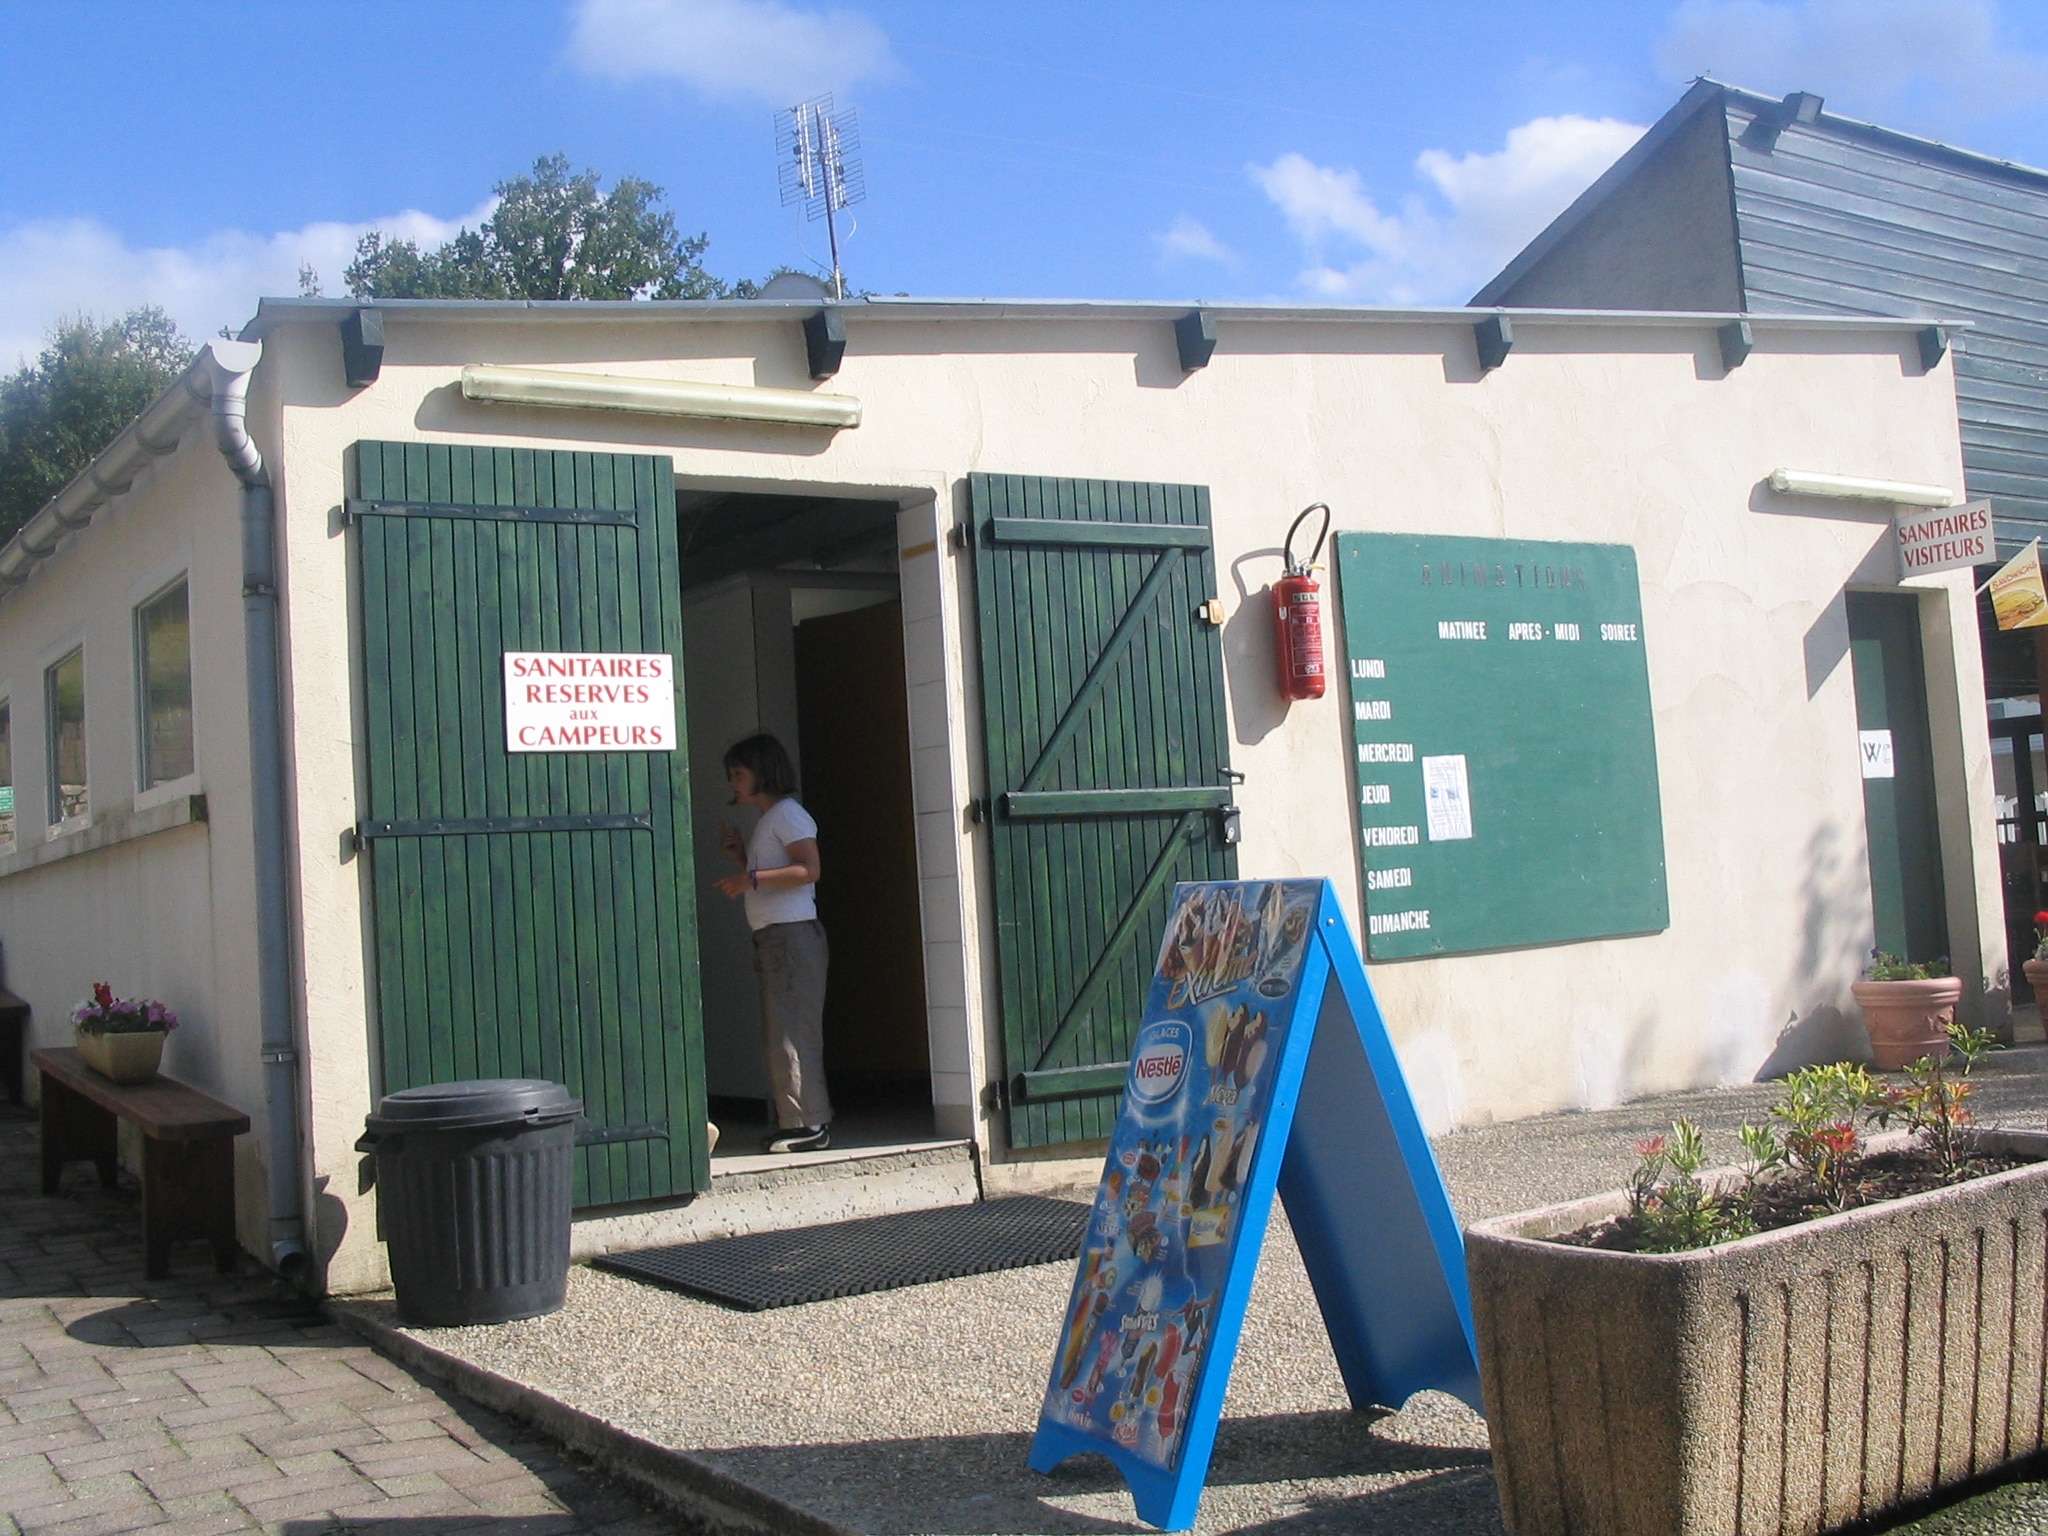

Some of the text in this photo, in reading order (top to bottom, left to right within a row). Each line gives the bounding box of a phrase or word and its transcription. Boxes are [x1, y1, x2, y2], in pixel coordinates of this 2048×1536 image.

[1899, 509, 1987, 545] SANITAIRES
[1904, 535, 1985, 567] VISITEURS
[1438, 621, 1487, 640] MATINEE
[1508, 622, 1542, 640] APRES
[1554, 623, 1580, 641] MIDI
[1601, 624, 1637, 641] SOIREE
[513, 658, 662, 678] SANITAIRES
[1351, 659, 1385, 678] LUNDI
[526, 684, 649, 703] RESERVES
[569, 709, 599, 721] aux
[1355, 701, 1391, 720] MARDI
[518, 725, 663, 746] CAMPEURS
[1358, 743, 1414, 762] MERCREDI
[1361, 785, 1391, 804] JEUDI
[1363, 826, 1419, 846] VENDREDI
[1368, 867, 1412, 890] SAMEDI
[1369, 910, 1431, 935] DIMANCHE
